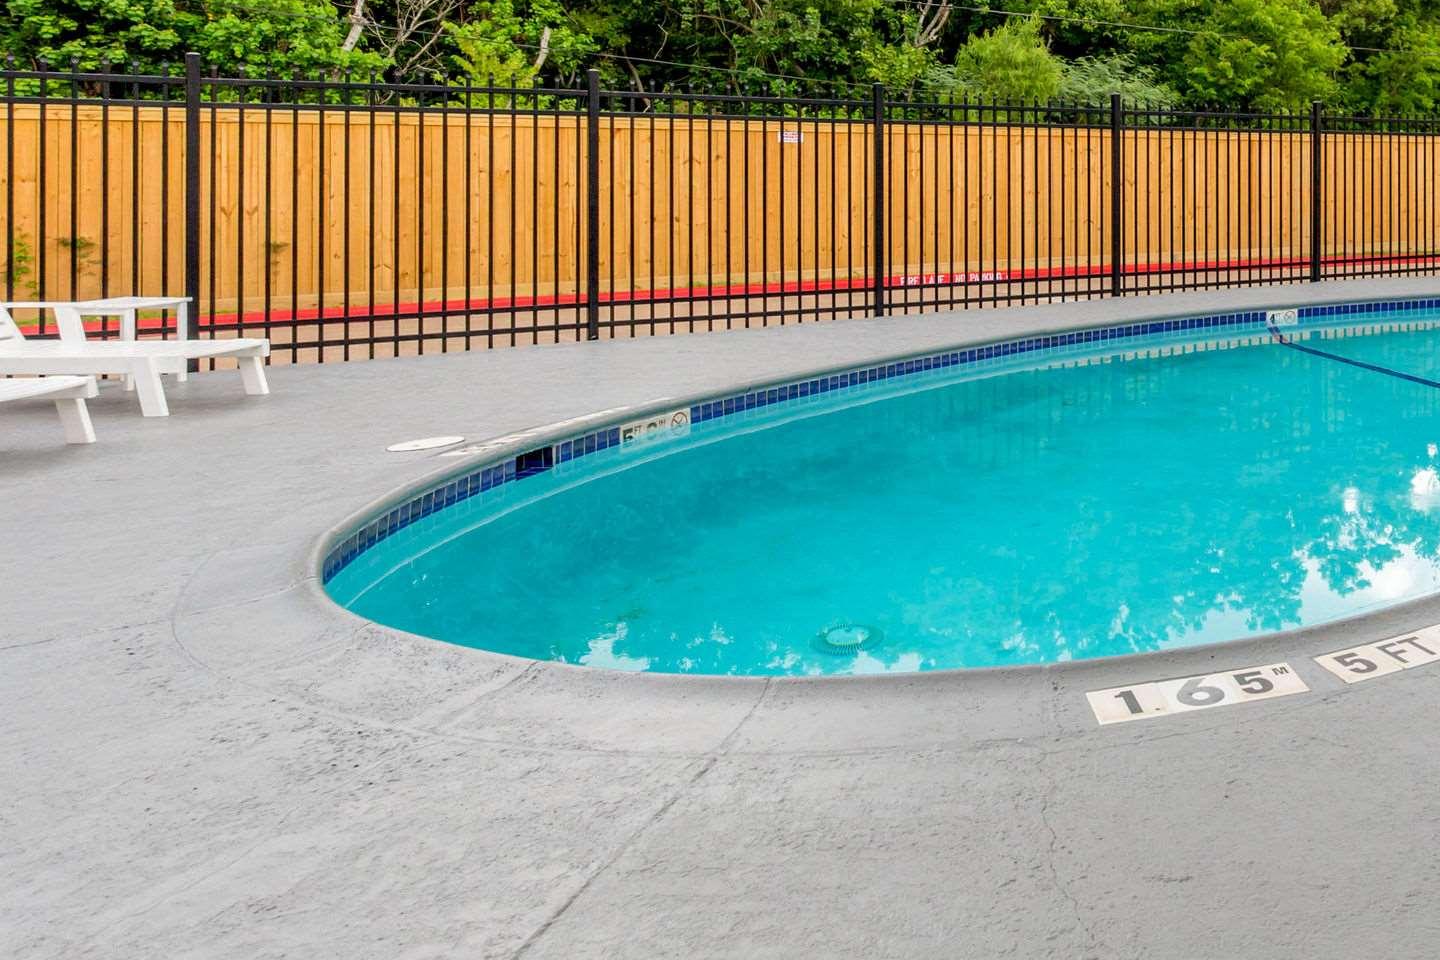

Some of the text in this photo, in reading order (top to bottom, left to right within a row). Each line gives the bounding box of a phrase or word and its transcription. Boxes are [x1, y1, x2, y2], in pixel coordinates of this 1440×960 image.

[900, 275, 920, 286] FRE
[923, 273, 945, 285] LAE
[1333, 652, 1378, 674] 5
[1376, 636, 1437, 664] FT
